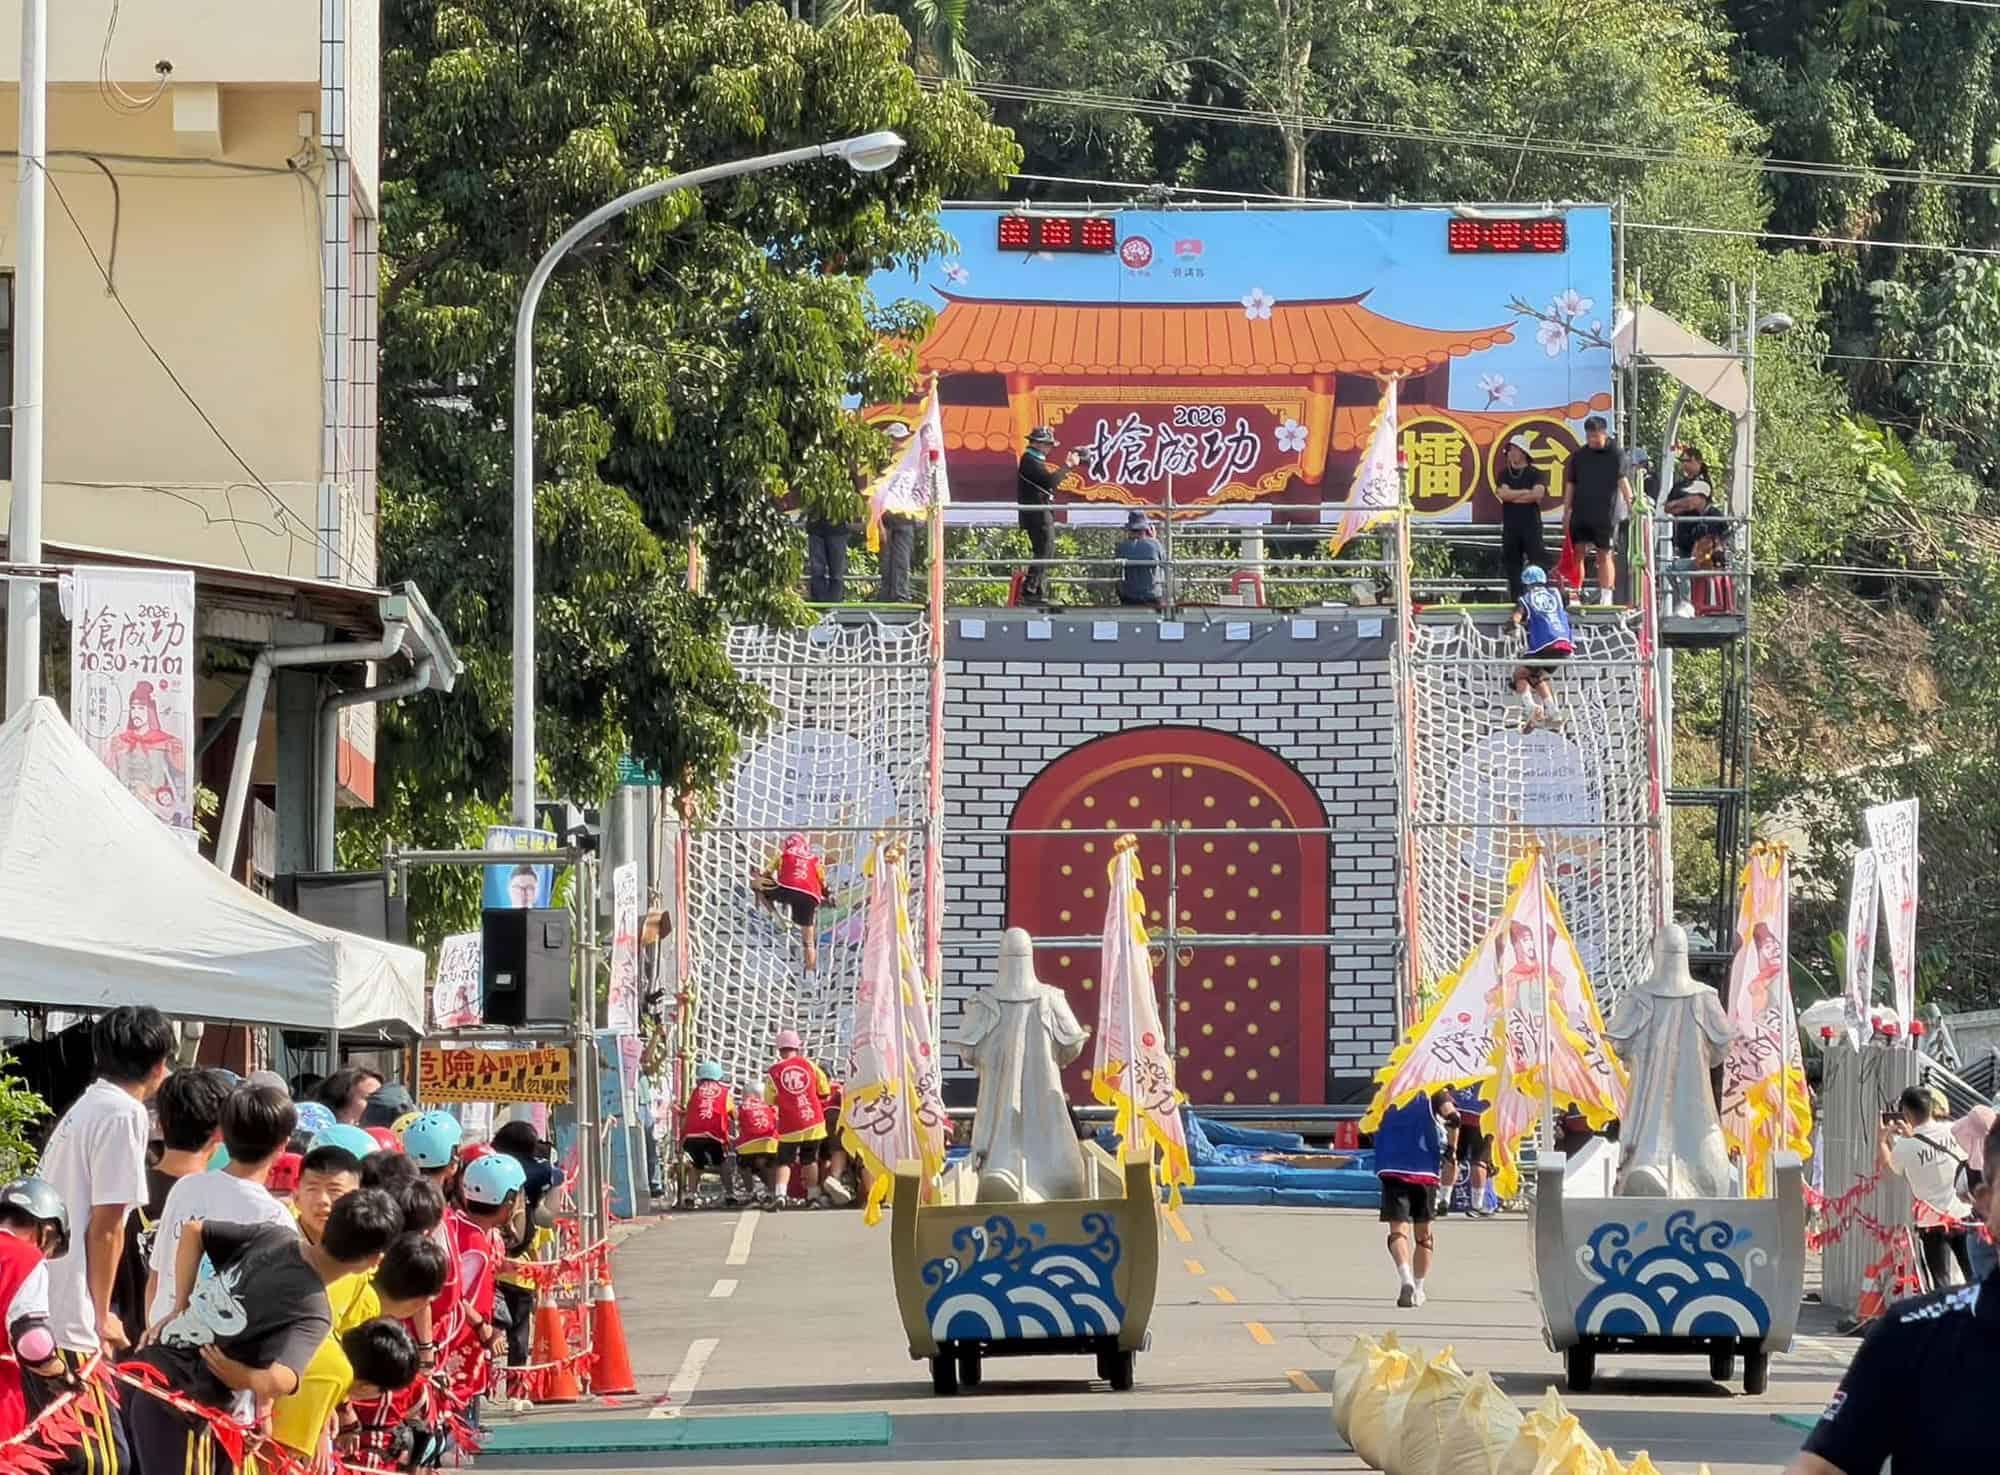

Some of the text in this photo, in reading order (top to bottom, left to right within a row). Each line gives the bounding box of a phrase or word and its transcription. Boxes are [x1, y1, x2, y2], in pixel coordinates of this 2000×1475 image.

[1173, 405, 1226, 426] 2026
[1087, 412, 1261, 496] 搶成功
[138, 604, 170, 619] 2026
